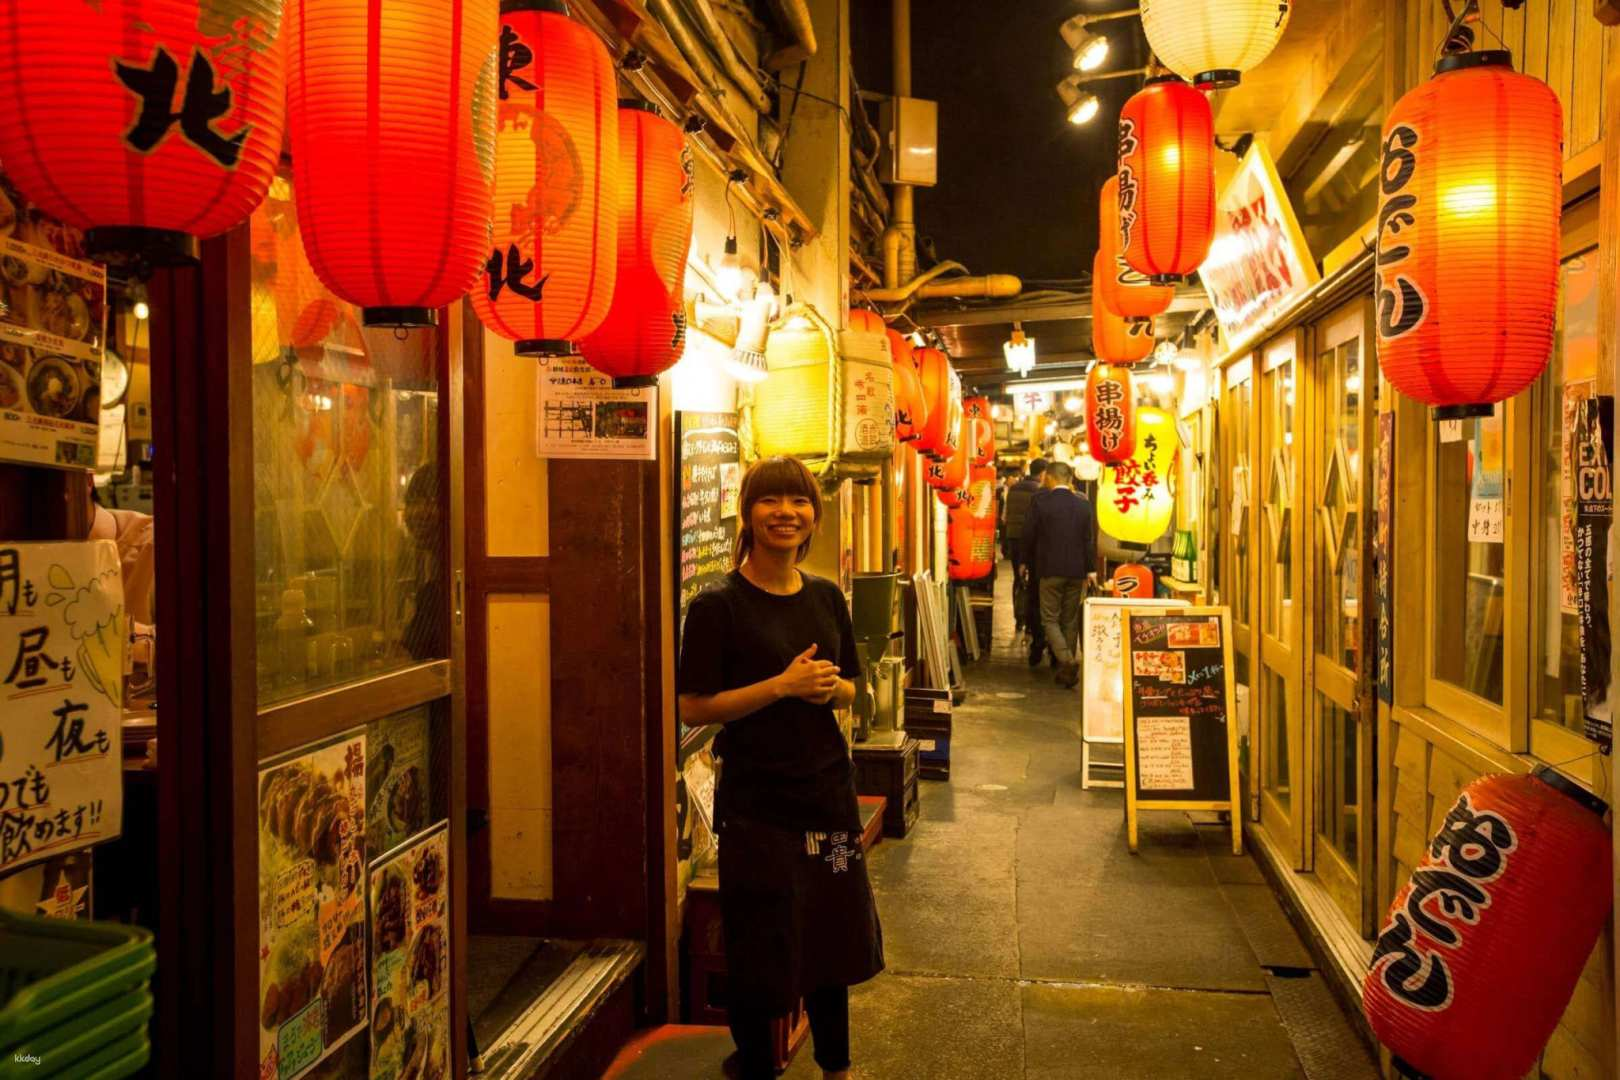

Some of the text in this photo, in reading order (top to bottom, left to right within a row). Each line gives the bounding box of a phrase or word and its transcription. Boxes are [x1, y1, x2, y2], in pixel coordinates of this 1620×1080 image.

[113, 45, 250, 170] 北
[486, 243, 549, 301] 北
[1095, 381, 1125, 451] 串揚げ
[1113, 457, 1142, 514] 餃子
[1117, 576, 1138, 598] ラ
[4, 625, 76, 689] 昼も
[45, 699, 110, 762] 夜も
[1370, 793, 1516, 1010] おでん
